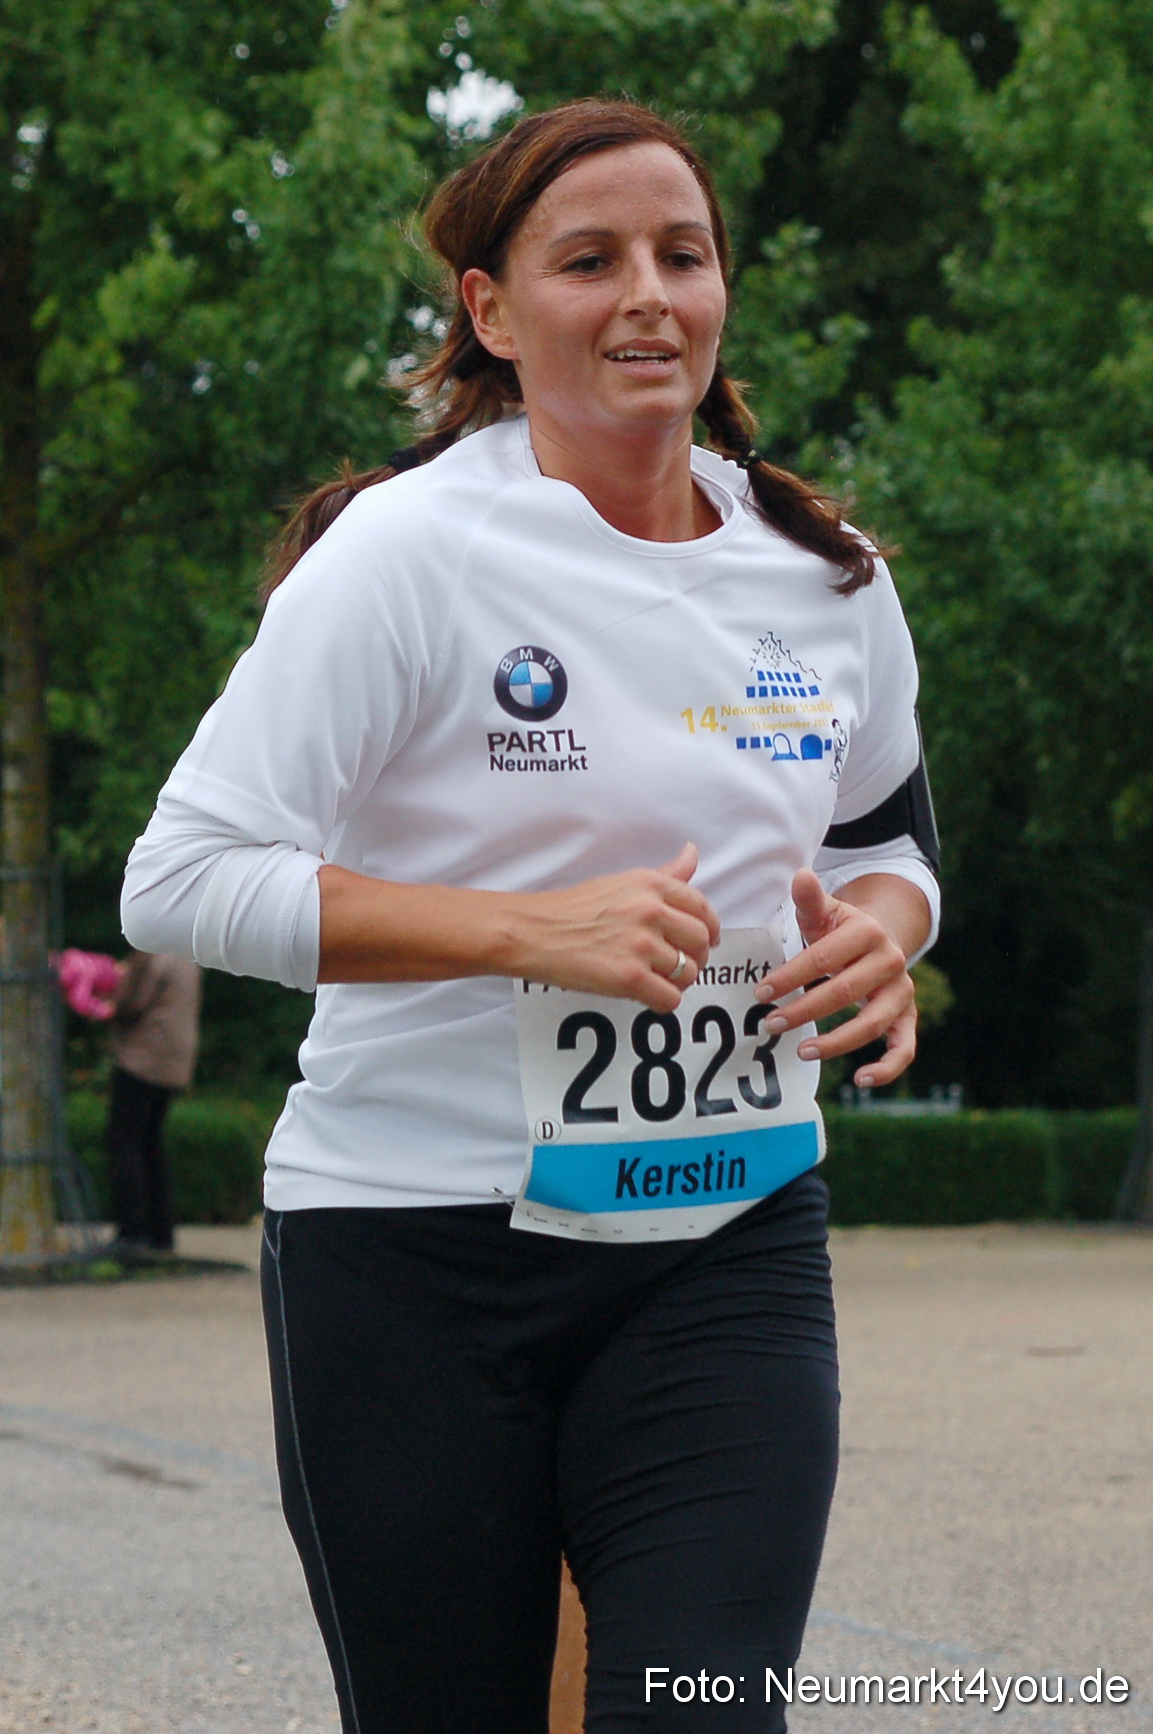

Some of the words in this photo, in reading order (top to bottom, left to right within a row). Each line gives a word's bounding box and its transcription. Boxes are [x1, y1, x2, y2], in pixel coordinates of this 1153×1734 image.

[500, 647, 559, 673] BMW
[680, 705, 728, 734] 14.
[721, 702, 797, 717] Neumarkter
[487, 729, 586, 753] PARTL
[490, 754, 588, 772] Neumarkt
[696, 959, 772, 985] markt
[557, 1003, 783, 1125] 2823
[541, 1121, 554, 1140] D
[615, 1150, 746, 1200] Kerstin
